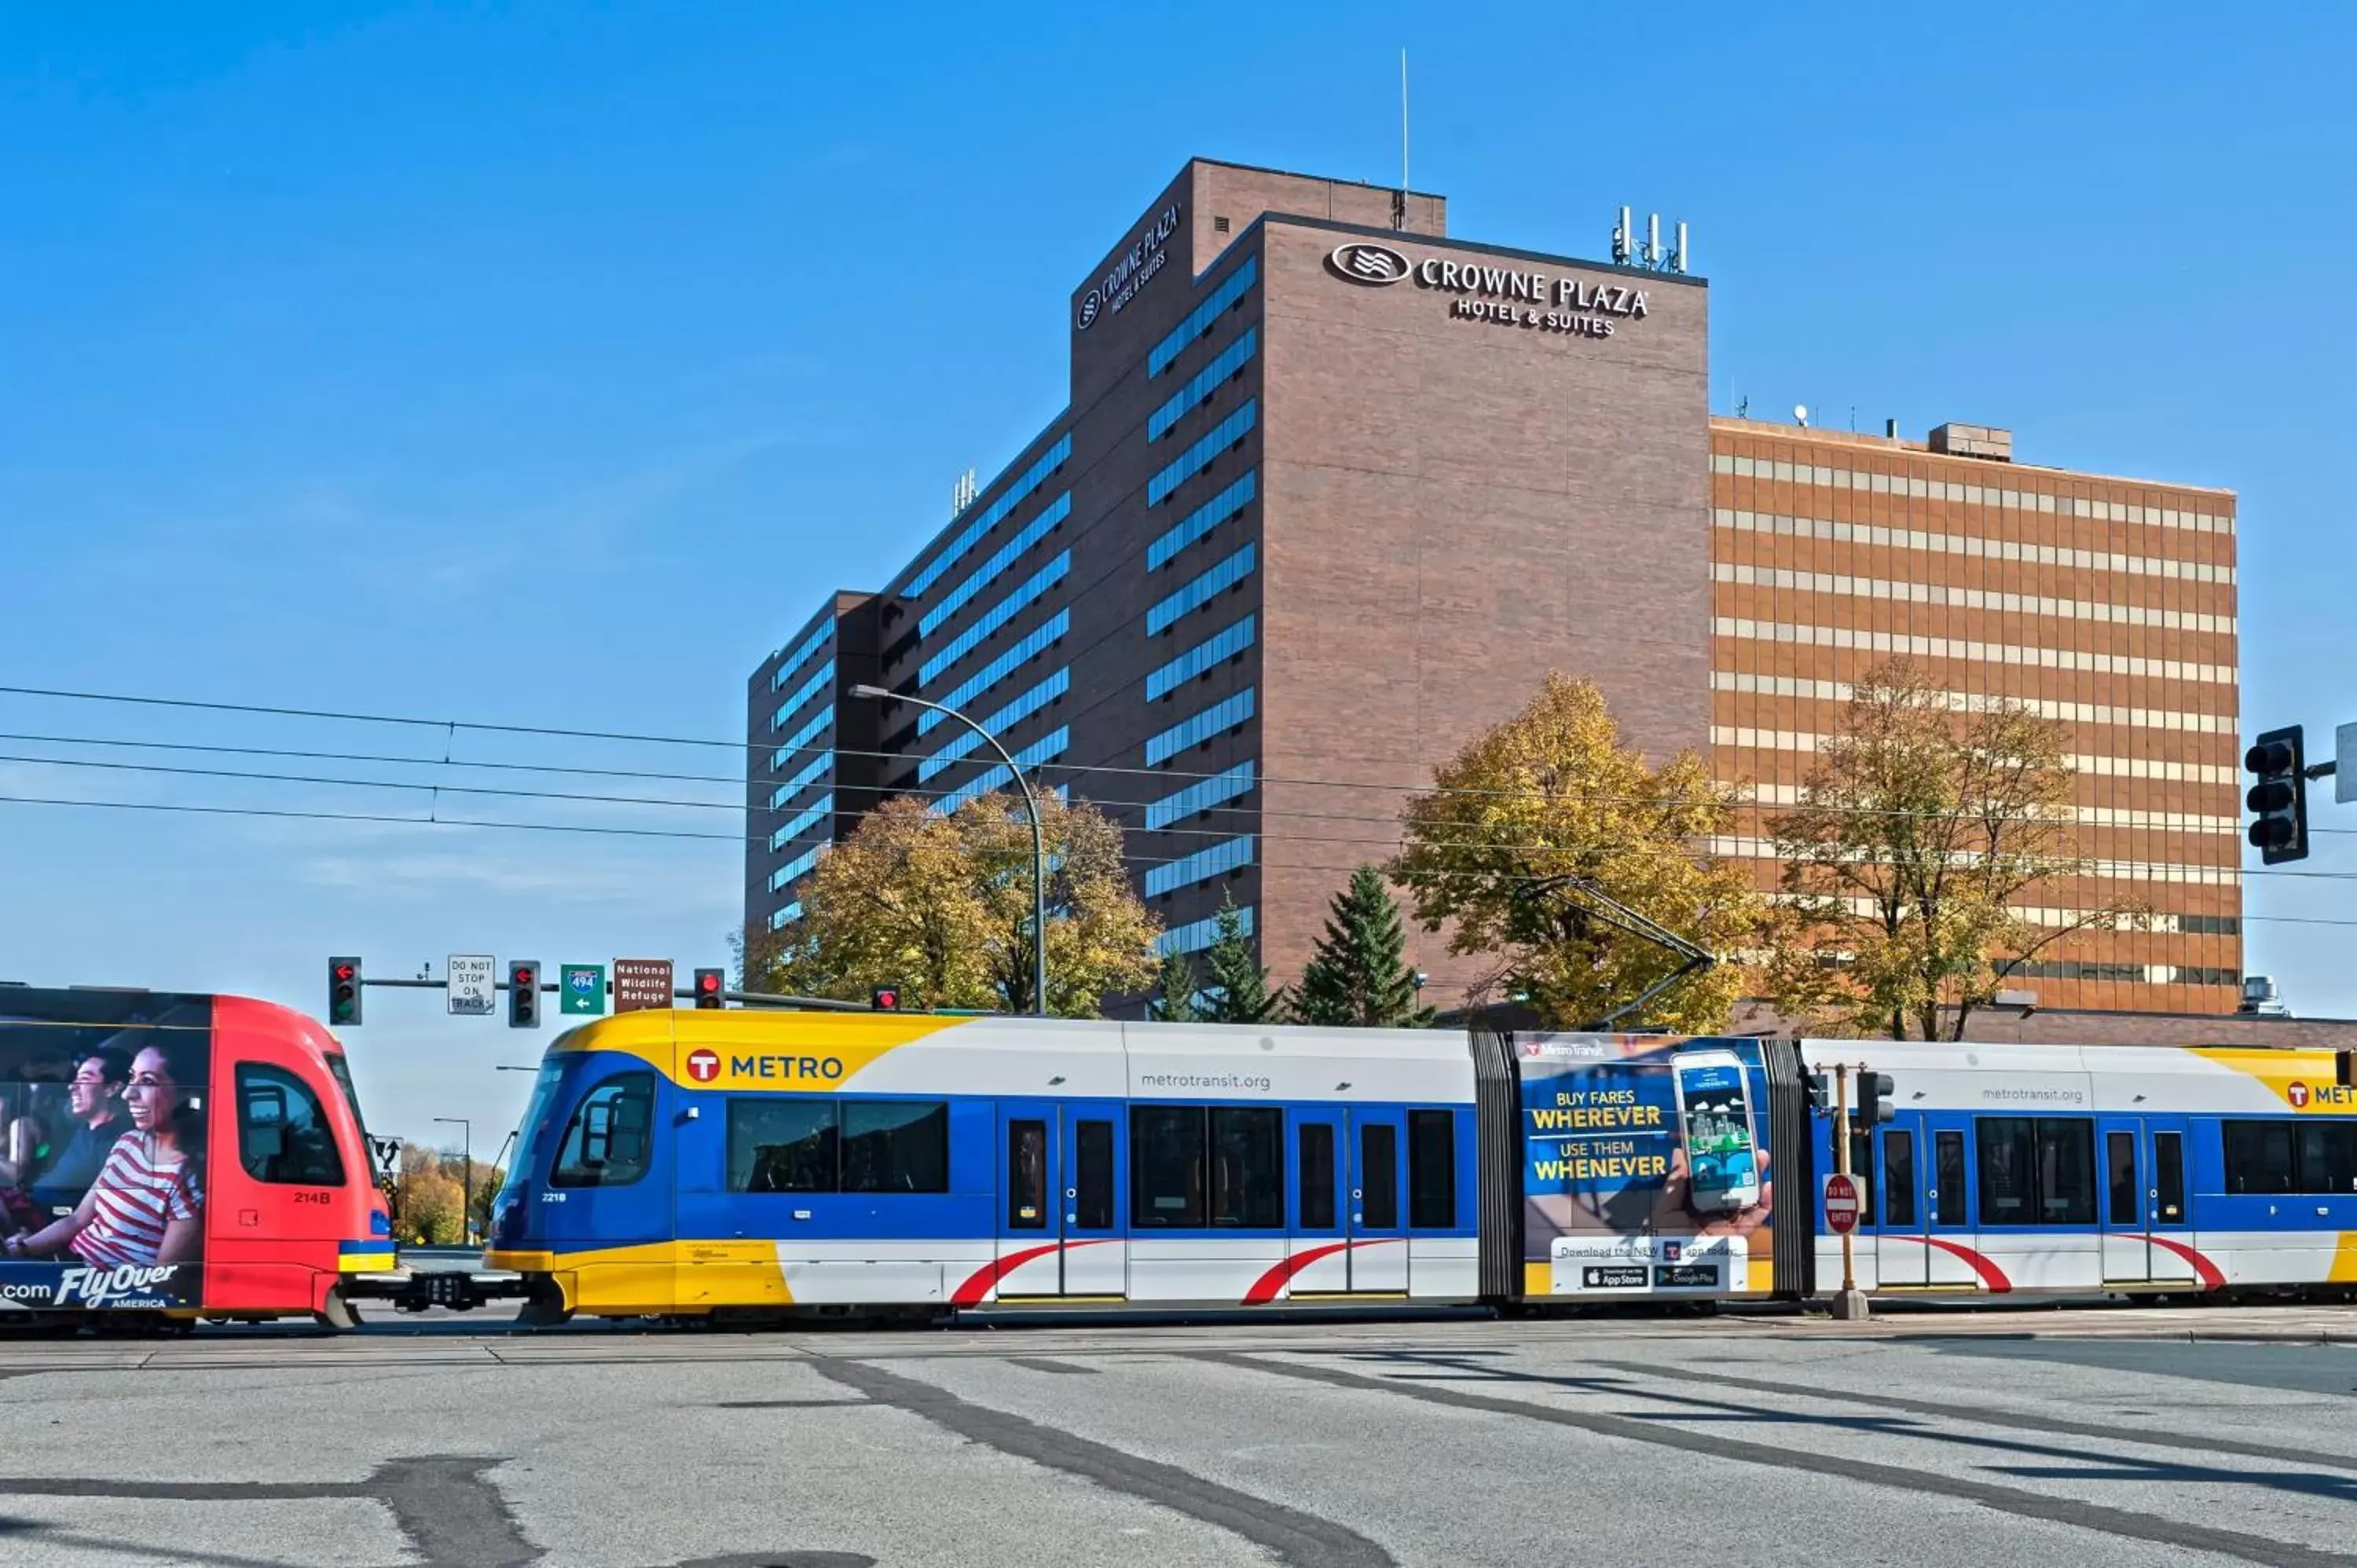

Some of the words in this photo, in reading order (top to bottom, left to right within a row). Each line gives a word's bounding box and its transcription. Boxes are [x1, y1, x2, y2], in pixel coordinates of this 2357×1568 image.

[1102, 242, 1142, 302] CROWNE
[1145, 204, 1178, 258] PLAZA
[1112, 287, 1133, 314] HOTEL
[1140, 250, 1165, 284] SUITES
[1421, 258, 1545, 300] CROWNE
[1560, 278, 1648, 315] PLAZA
[1458, 299, 1519, 322] HOTEL
[1528, 309, 1540, 324] &
[1548, 311, 1615, 335] SUITES
[452, 961, 466, 970] DO
[471, 961, 490, 971] NOT
[617, 964, 670, 976] National
[458, 973, 486, 984] STOP
[573, 977, 593, 988] 494
[621, 978, 666, 989] Wildlife
[464, 986, 478, 996] ON
[621, 991, 665, 1003] Refuge
[731, 1055, 843, 1079] METRO
[1142, 1073, 1270, 1091] metrotransit.org
[1557, 1092, 1585, 1106] BUY
[1590, 1090, 1635, 1105] FARES
[1983, 1089, 2082, 1103] metrotransit.org
[1533, 1105, 1662, 1129] WHEREVER
[1560, 1143, 1588, 1157] USE
[1592, 1141, 1633, 1155] THEM
[1534, 1156, 1666, 1181] WHENEVER
[294, 1192, 330, 1204] 214B
[1561, 1247, 1611, 1257] Download
[53, 1264, 178, 1309] FlyOver
[1603, 1275, 1621, 1286] App
[1622, 1275, 1644, 1284] Store
[112, 1299, 166, 1308] AMERICA
